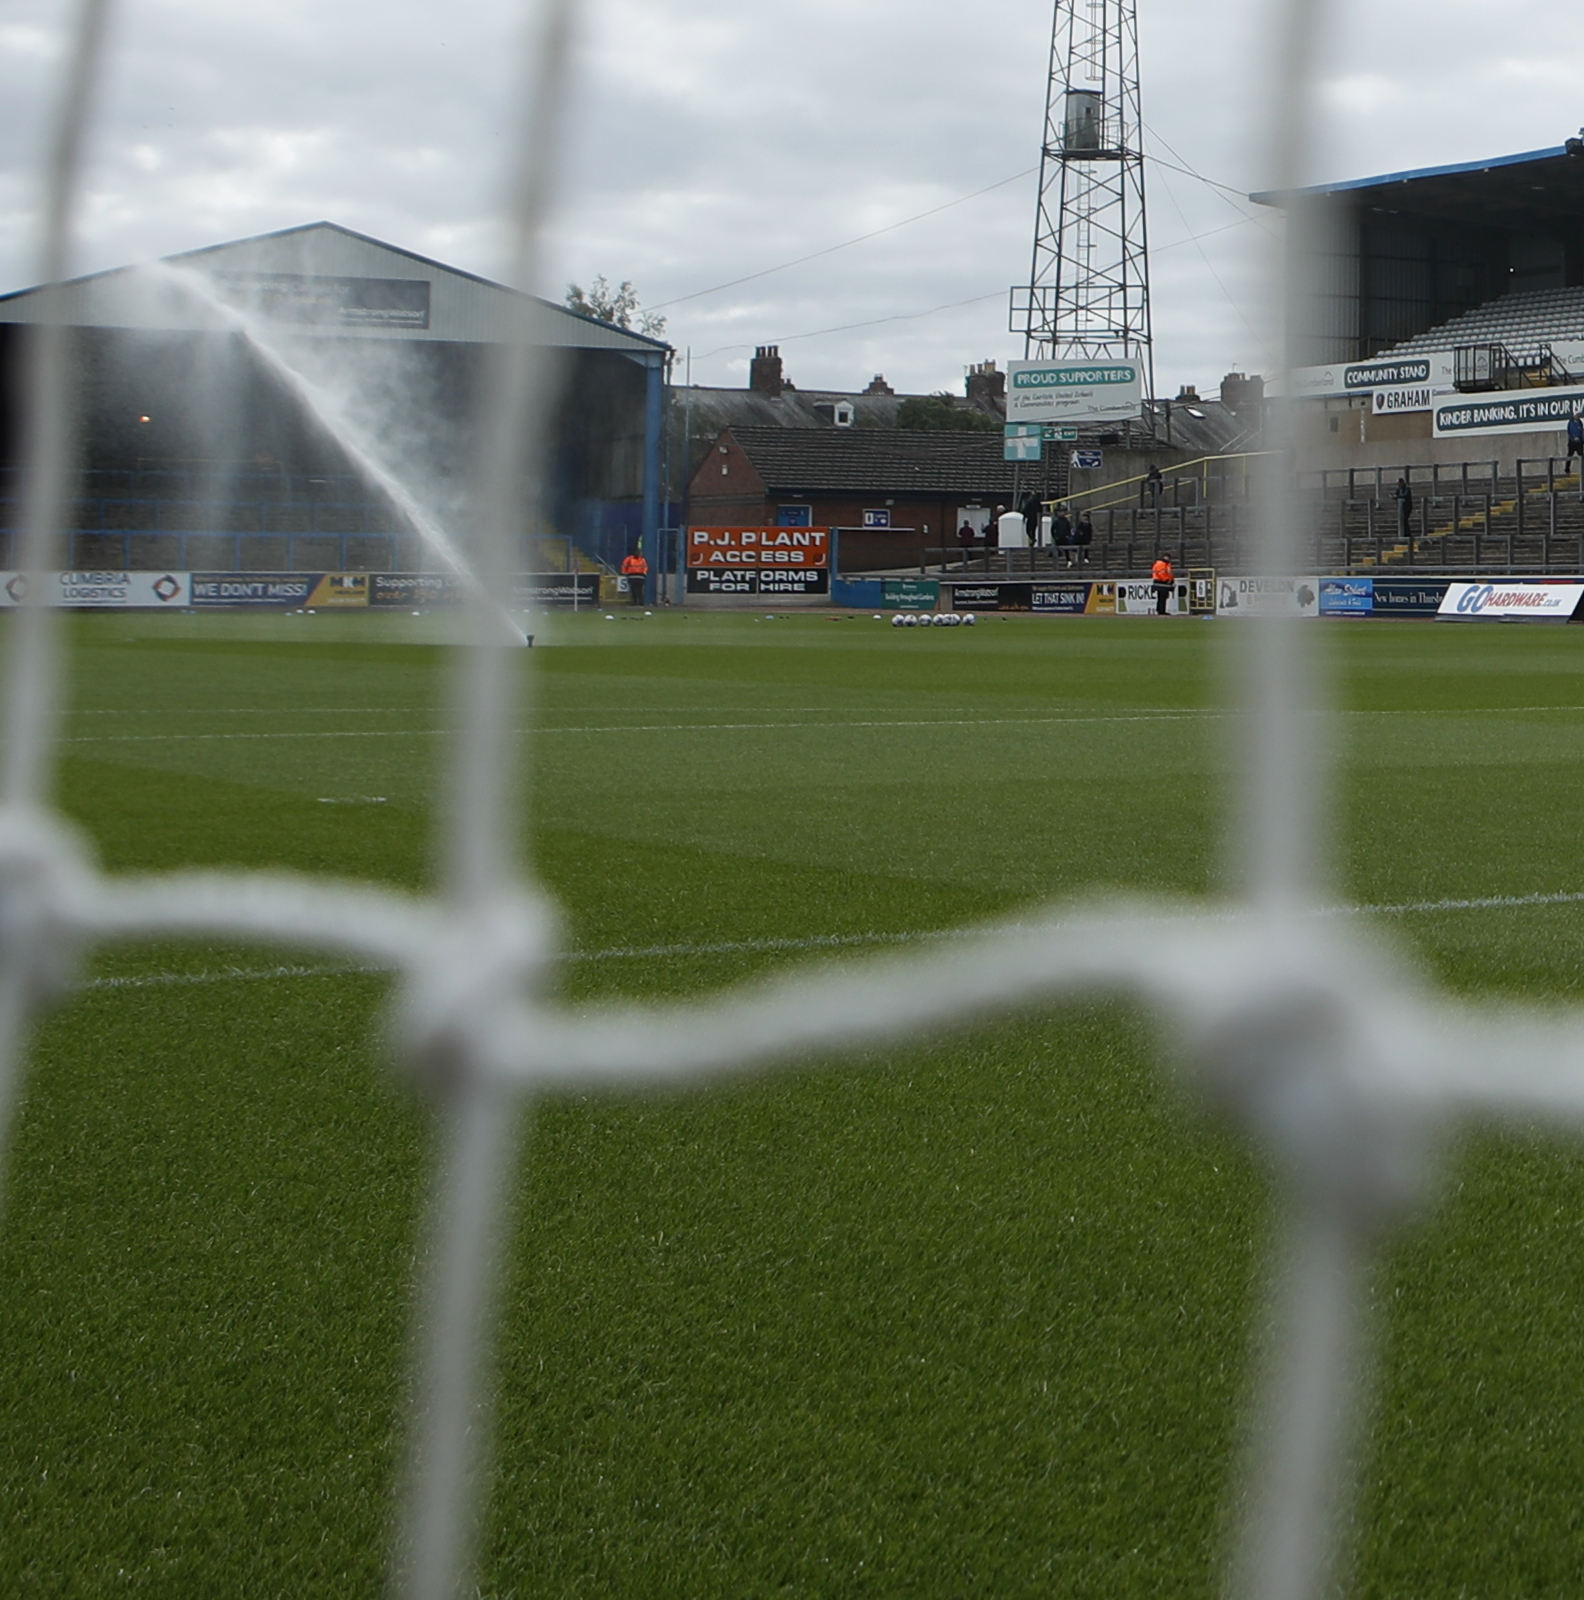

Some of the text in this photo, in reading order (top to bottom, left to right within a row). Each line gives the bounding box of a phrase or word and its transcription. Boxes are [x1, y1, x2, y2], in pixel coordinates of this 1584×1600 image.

[1018, 369, 1132, 385] PROUD SUPPORTERS
[1347, 364, 1427, 384] COMMUNITY STAND
[1386, 388, 1431, 409] GRAHAM
[1439, 410, 1472, 426] KINDER
[1474, 405, 1517, 423] BANKING.
[1519, 402, 1535, 418] IT'S
[1537, 401, 1549, 416] IN
[1550, 399, 1571, 415] OUR
[693, 531, 826, 546] P.J. PLANT
[709, 550, 805, 563] ACCESS
[59, 572, 132, 586] CUMBRIA
[329, 575, 366, 588] MKM
[696, 570, 818, 581] PLATFORMS
[194, 582, 307, 597] WE DON'T MISS!
[375, 576, 443, 590] Supporting
[709, 582, 806, 592] FOR HIRE
[1240, 580, 1294, 593] DEVELON
[62, 586, 128, 599] LOGISTICS
[1097, 584, 1115, 596] MKM
[1032, 593, 1043, 604] LET
[1045, 593, 1059, 604] THAT
[1060, 593, 1074, 604] SINK
